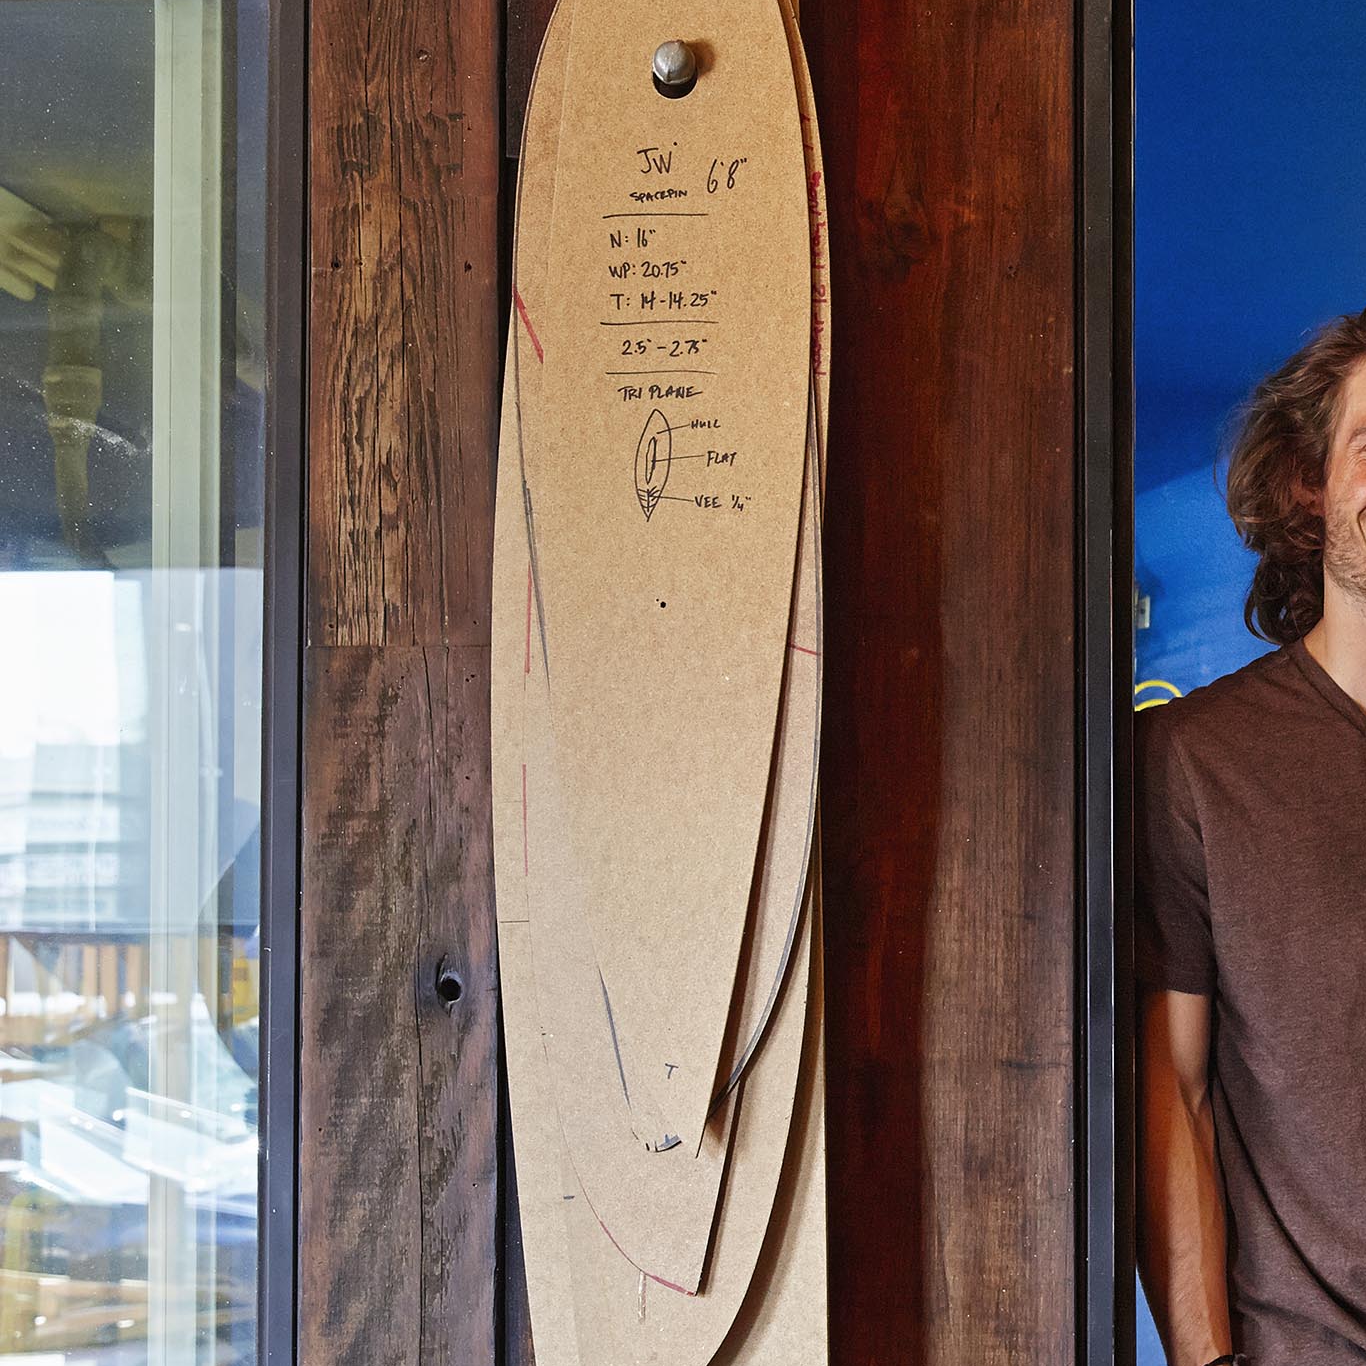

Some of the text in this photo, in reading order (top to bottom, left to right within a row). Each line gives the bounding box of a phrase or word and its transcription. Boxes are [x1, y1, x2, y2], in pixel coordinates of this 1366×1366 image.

[609, 230, 629, 248] N:
[608, 262, 636, 279] WP:
[610, 293, 631, 310] T:
[617, 385, 703, 401] TRI PLANE
[707, 450, 737, 467] FLAT
[695, 495, 722, 508] VEE
